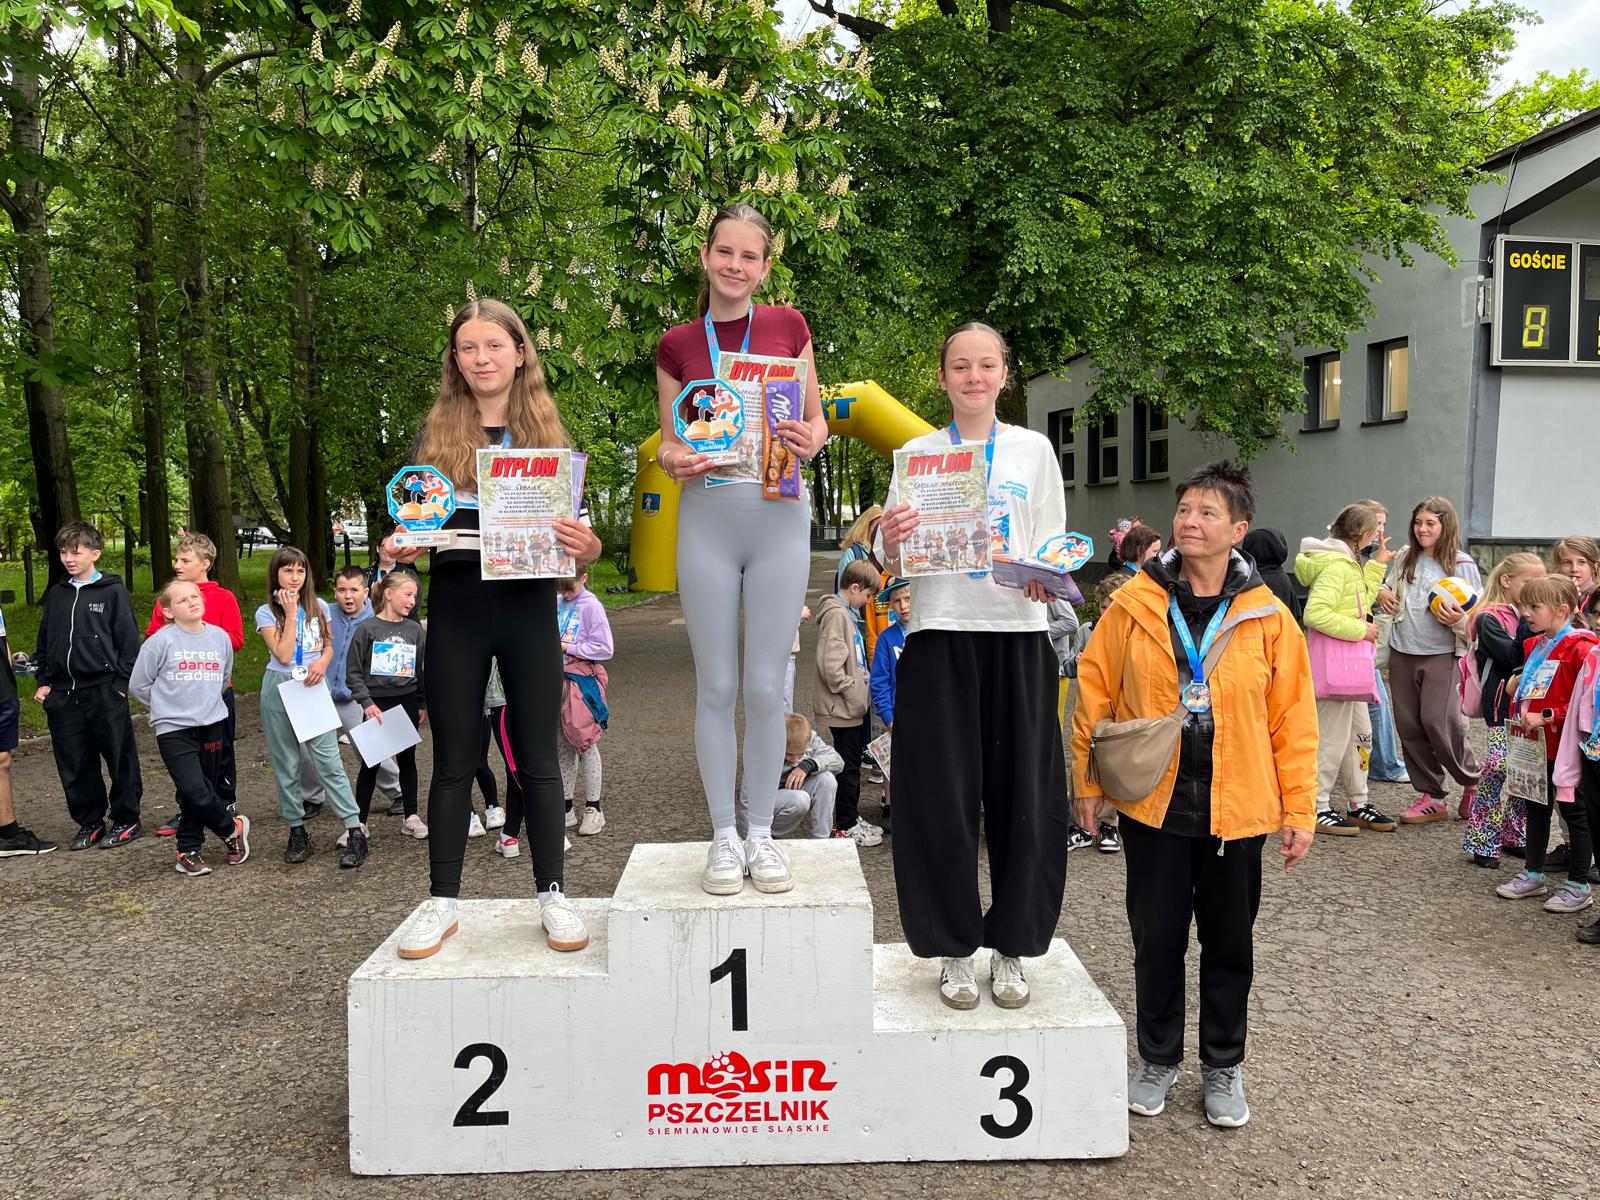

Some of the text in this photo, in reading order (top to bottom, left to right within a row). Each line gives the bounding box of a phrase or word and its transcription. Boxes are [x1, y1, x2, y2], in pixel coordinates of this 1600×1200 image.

[1509, 250, 1566, 269] GOŚCIE
[490, 457, 559, 477] DYPLOM
[907, 452, 973, 476] DYPLOM
[174, 649, 221, 661] street
[386, 652, 406, 667] 141
[178, 660, 220, 671] dance
[710, 948, 748, 1031] 1
[452, 1042, 509, 1127] 2
[979, 1055, 1033, 1139] 3
[648, 1100, 830, 1124] PSZCZELNIK
[648, 1125, 758, 1135] SIEMIANOWICE
